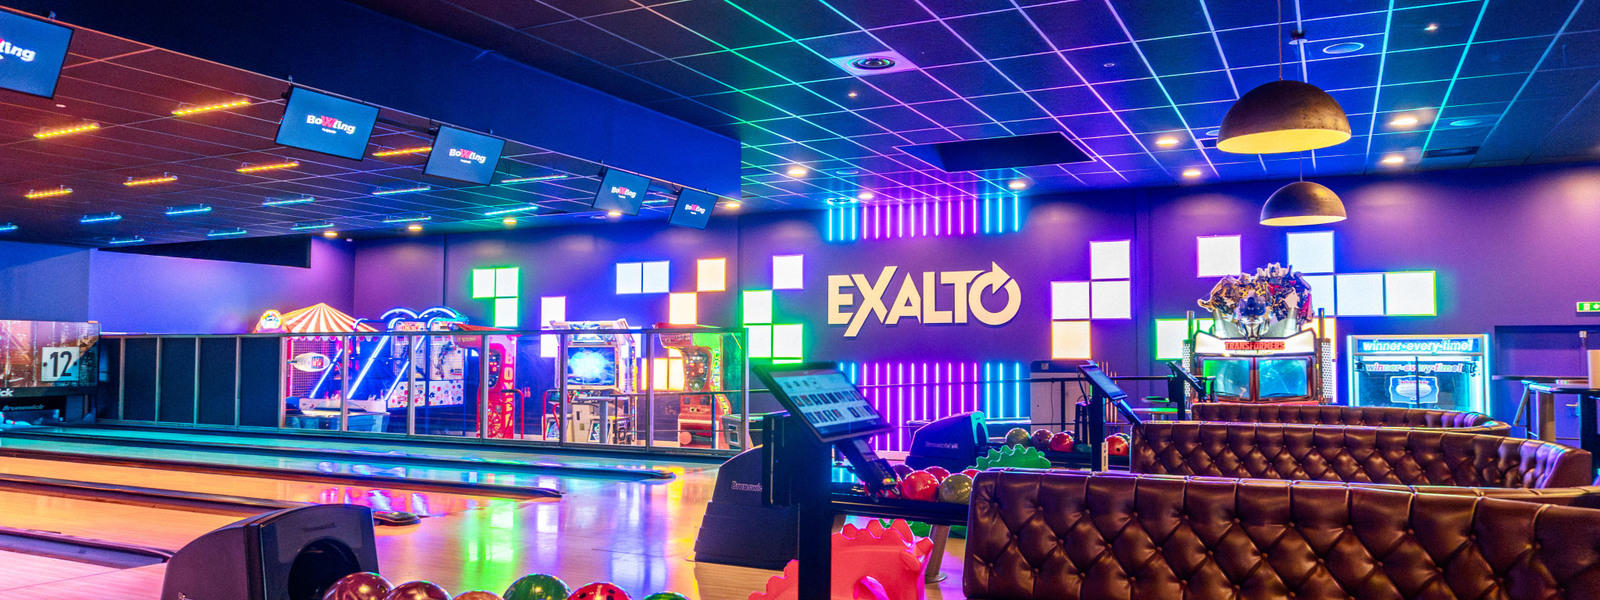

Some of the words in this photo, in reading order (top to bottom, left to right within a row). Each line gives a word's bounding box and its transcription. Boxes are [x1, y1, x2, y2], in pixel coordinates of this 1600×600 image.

[0, 39, 36, 61] ling
[827, 260, 1022, 338] EXALTO
[1225, 341, 1285, 351] TRANSFORMERS
[49, 350, 73, 378] 12
